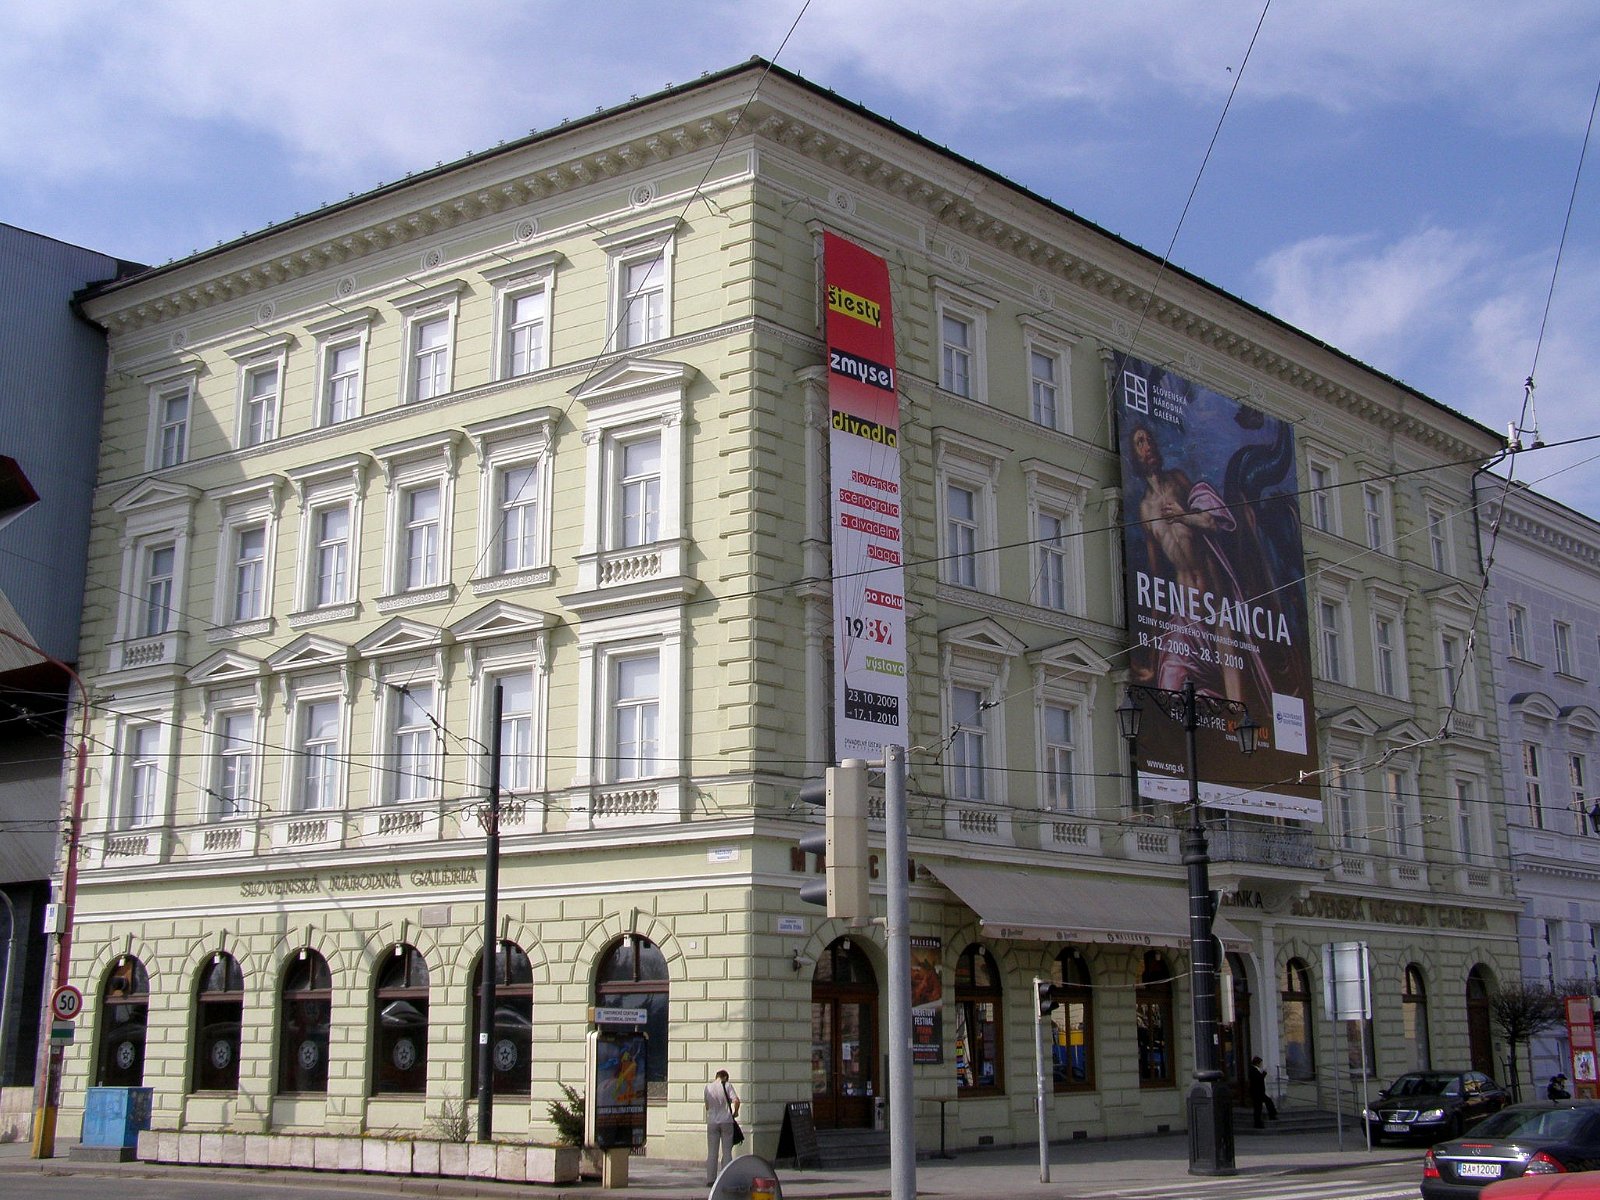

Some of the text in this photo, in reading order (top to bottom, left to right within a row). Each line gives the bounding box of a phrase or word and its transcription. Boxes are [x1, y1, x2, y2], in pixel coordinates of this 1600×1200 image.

[828, 285, 881, 328] šiesty
[830, 352, 894, 389] zmysel
[832, 411, 897, 447] divadla
[865, 591, 903, 607] po roku
[1136, 571, 1292, 646] RENESANCIA
[1137, 614, 1158, 627] DEJINY
[845, 616, 893, 646] 1989
[1167, 640, 1190, 657] 2009
[1200, 647, 1213, 663] 28.
[1224, 653, 1244, 670] 2010
[866, 656, 905, 675] výstava
[848, 689, 898, 708] 23. 10. 2009
[877, 712, 898, 725] 2010
[1210, 716, 1227, 732] PRE
[1146, 758, 1185, 774] www.sng.sk
[240, 864, 479, 898] SLOVENSKÁ NÁRODNÁ GALÉRIA
[59, 994, 76, 1011] 50
